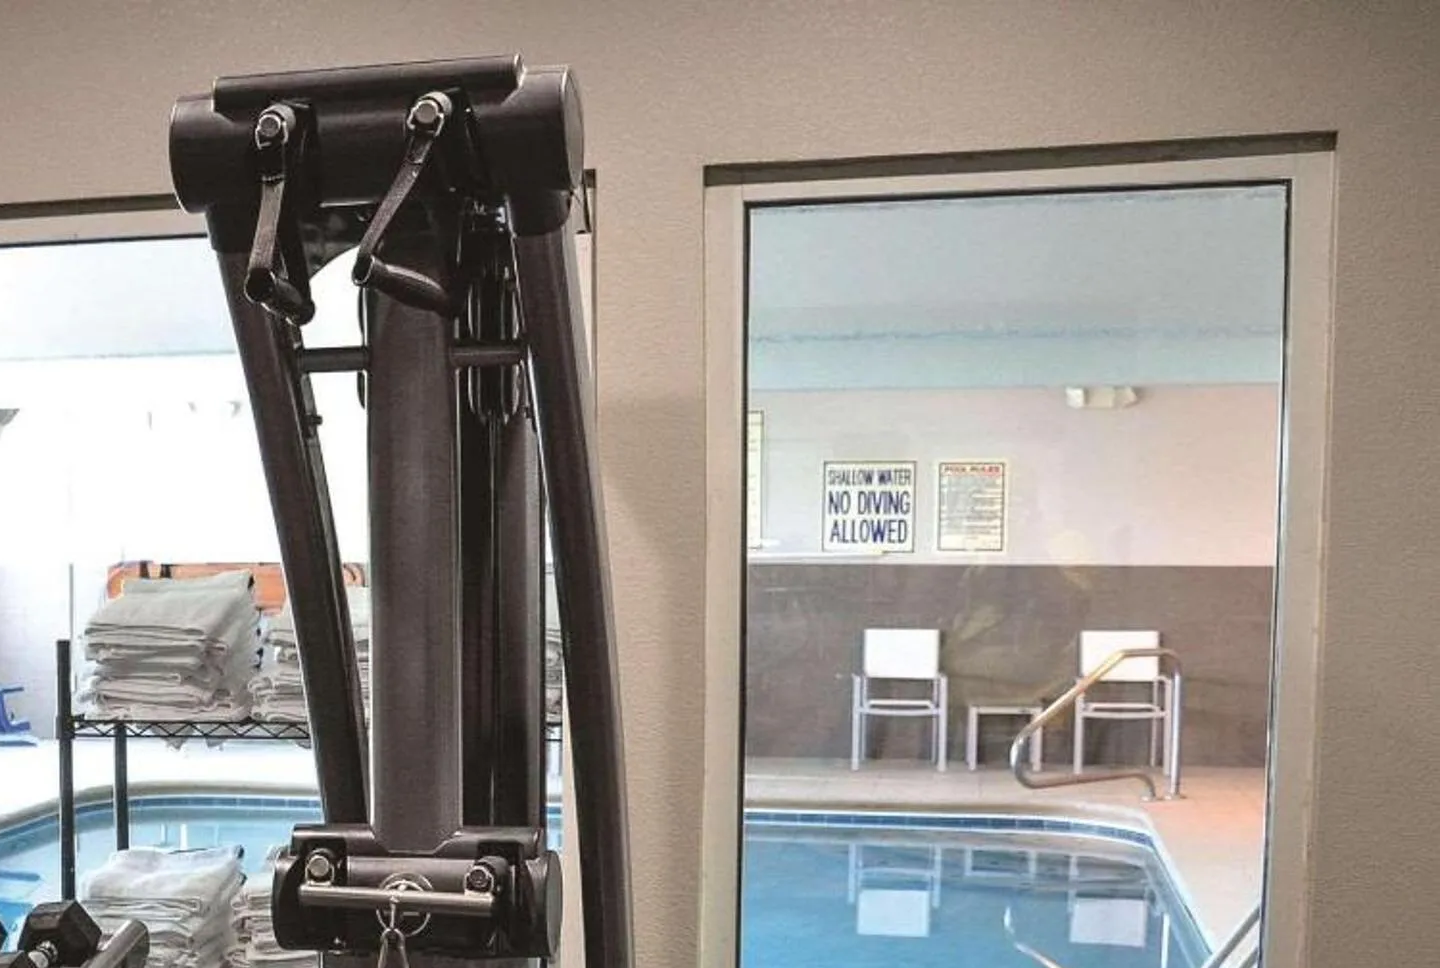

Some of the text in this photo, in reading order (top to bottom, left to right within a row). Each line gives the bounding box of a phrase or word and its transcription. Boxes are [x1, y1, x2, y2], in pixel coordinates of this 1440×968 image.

[828, 468, 912, 486] SHALLOW WATER
[828, 490, 911, 515] NO DIVING
[829, 518, 908, 544] ALLOWED
